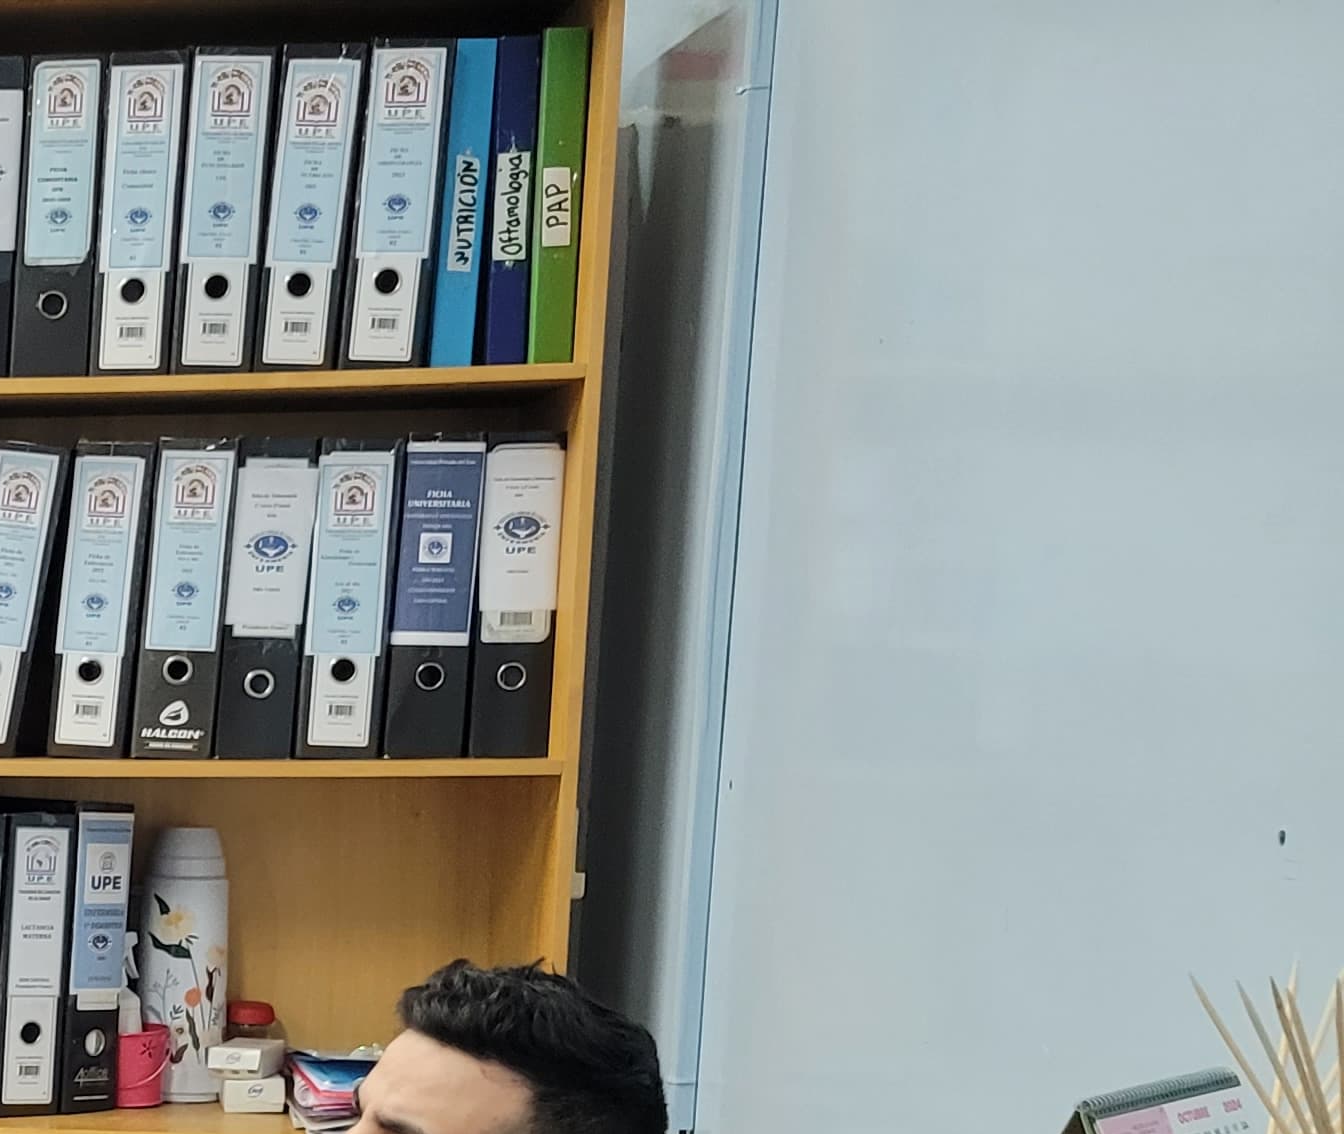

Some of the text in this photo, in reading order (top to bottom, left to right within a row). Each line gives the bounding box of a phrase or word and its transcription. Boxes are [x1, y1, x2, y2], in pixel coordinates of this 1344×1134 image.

[545, 184, 569, 228] PAP
[454, 159, 478, 266] NUTRICIÓN
[427, 489, 453, 498] FICHA
[408, 500, 471, 508] UNIVERSITARIA
[506, 546, 536, 554] UPE
[256, 565, 284, 573] UPE
[90, 875, 123, 890] UPE
